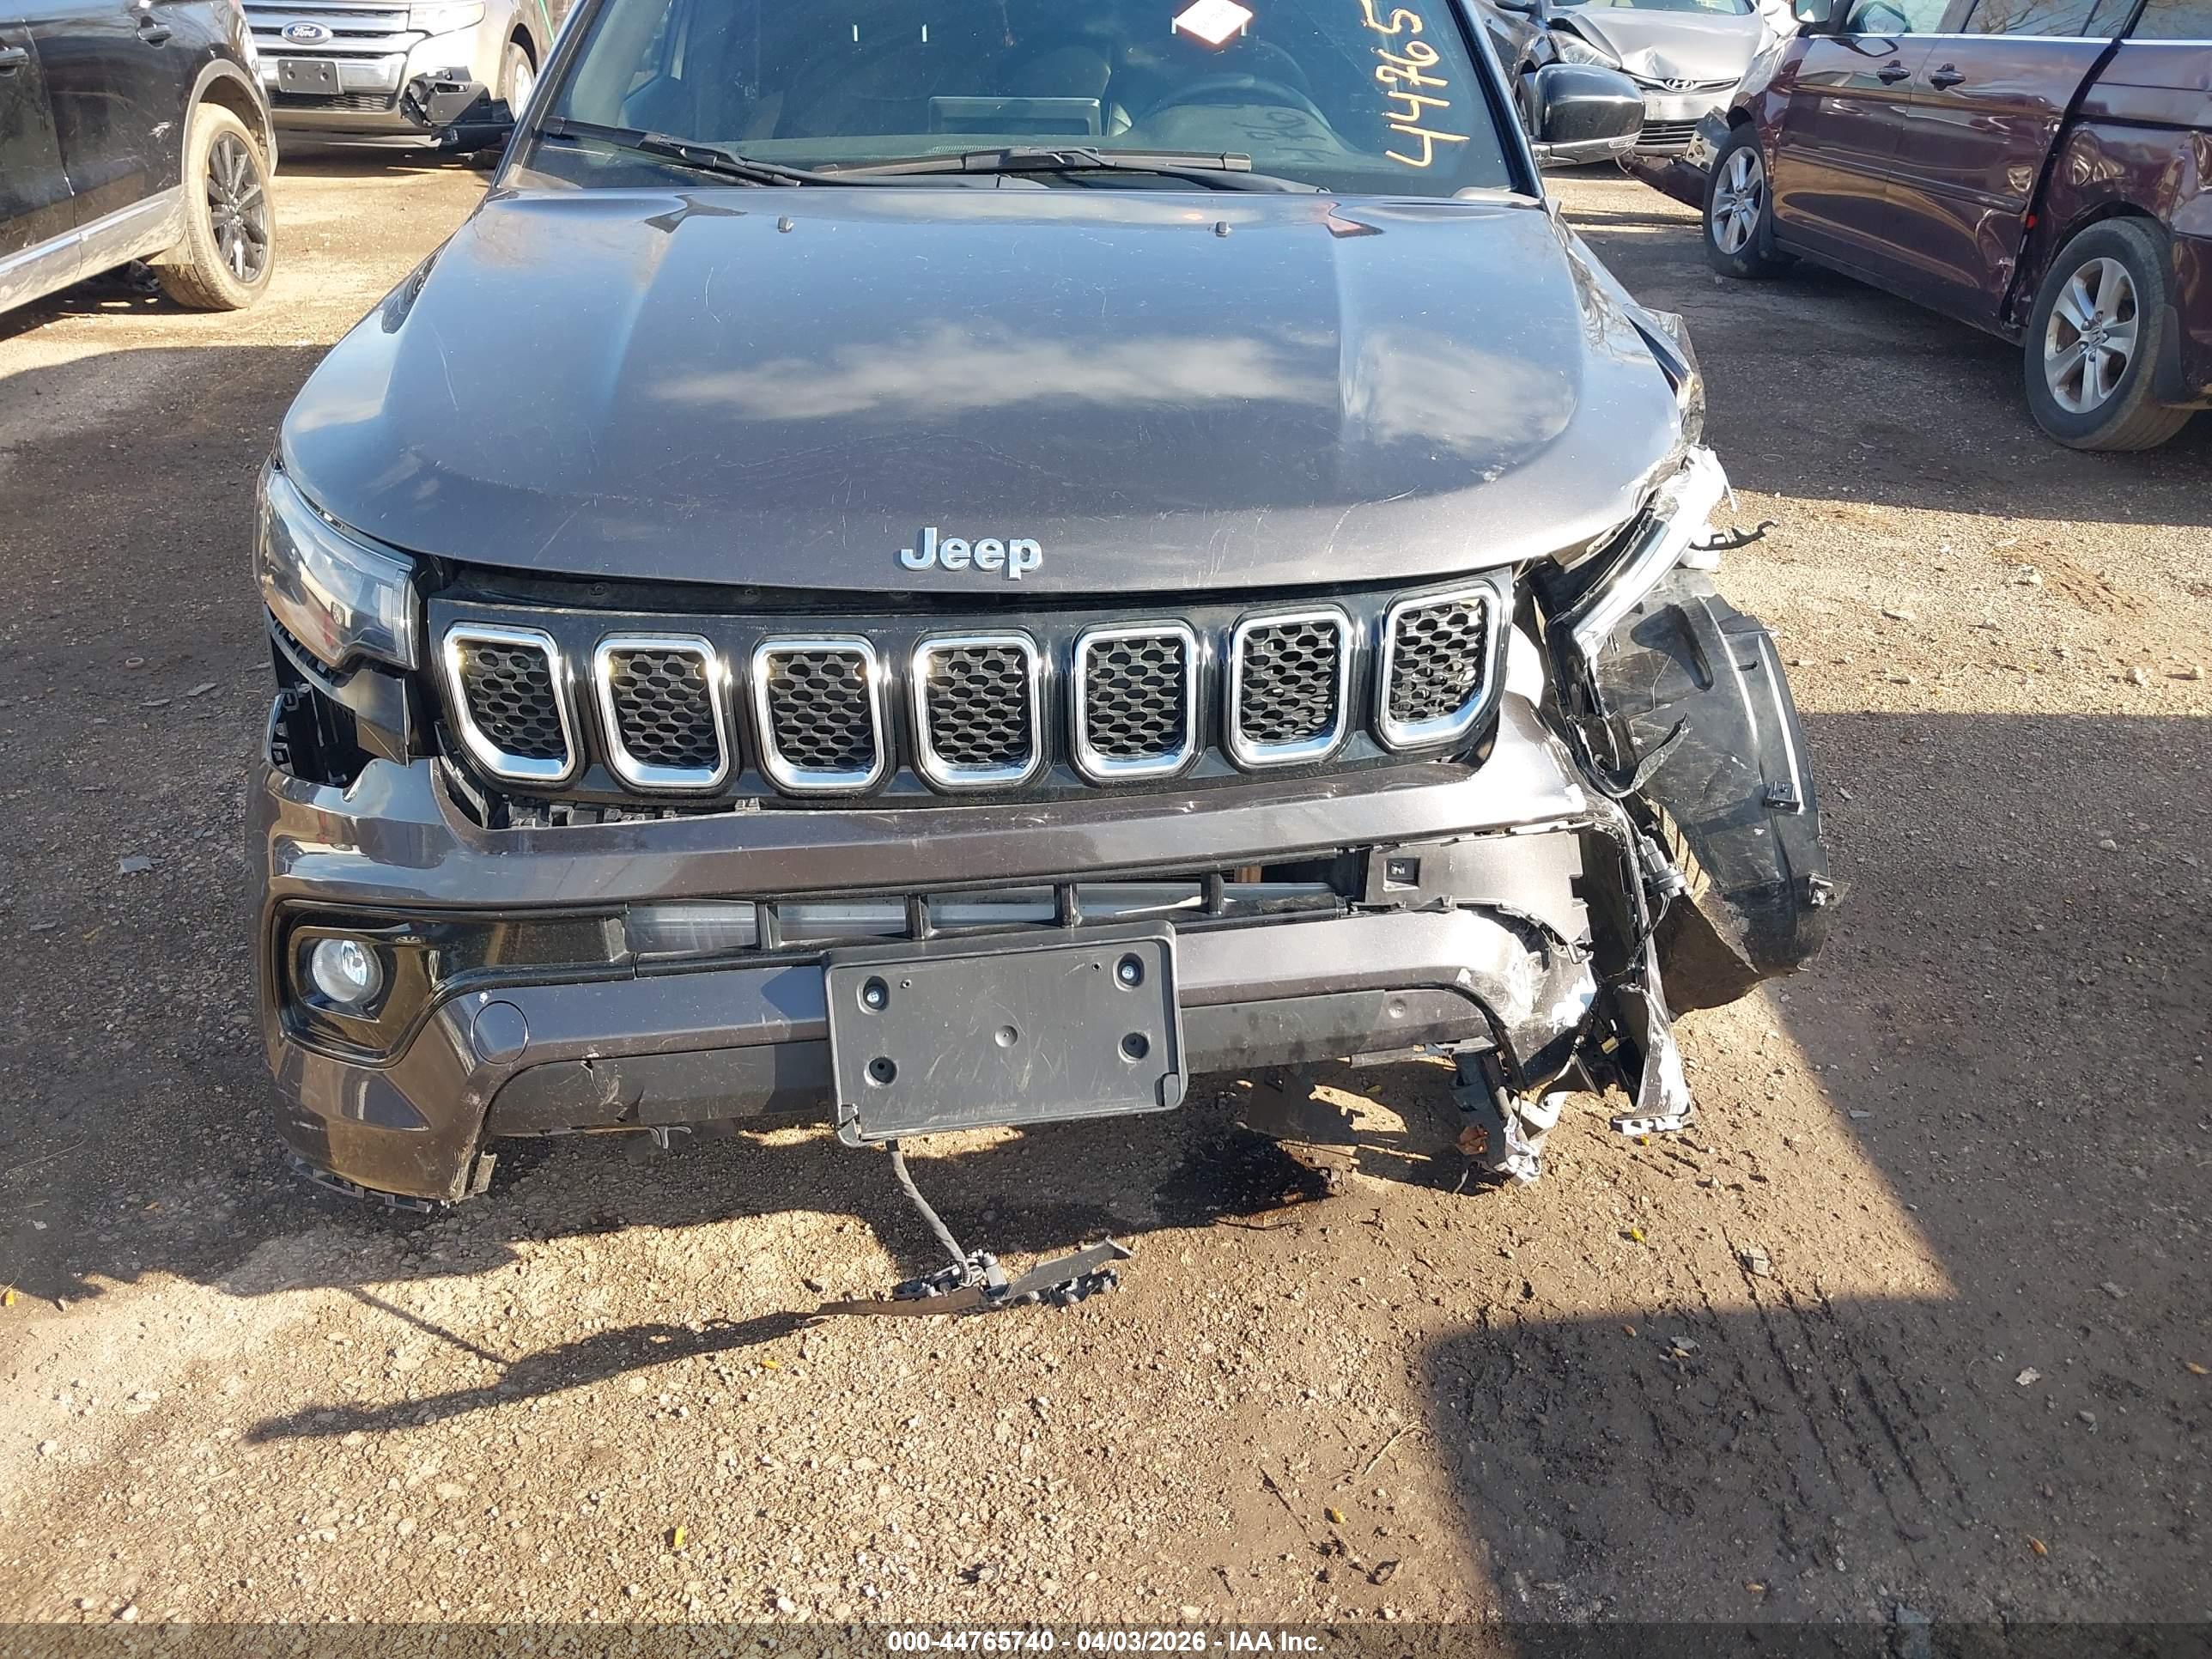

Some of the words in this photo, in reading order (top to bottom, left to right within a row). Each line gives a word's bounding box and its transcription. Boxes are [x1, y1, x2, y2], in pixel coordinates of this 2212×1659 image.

[293, 26, 316, 37] Ford
[1360, 0, 1470, 167] 44765
[901, 526, 1042, 580] Jeep
